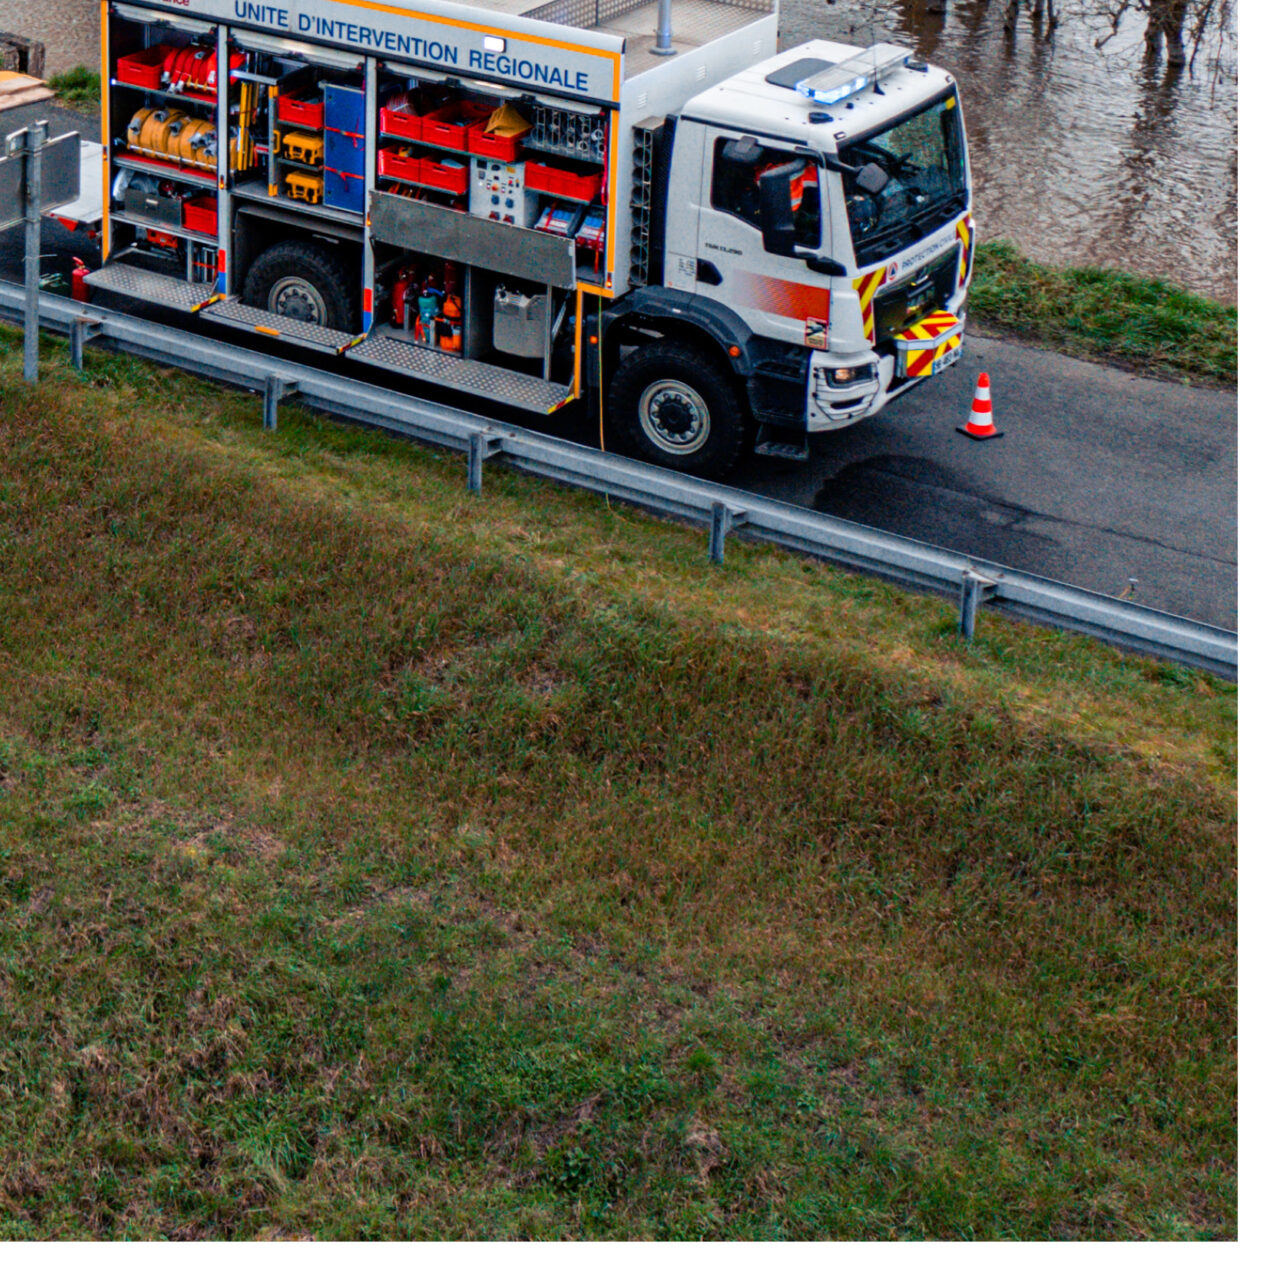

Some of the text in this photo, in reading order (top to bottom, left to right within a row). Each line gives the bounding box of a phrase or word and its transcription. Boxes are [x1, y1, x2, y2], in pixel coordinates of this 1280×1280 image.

[234, 0, 590, 93] UNITE D'INTERVENTION REGIONALE
